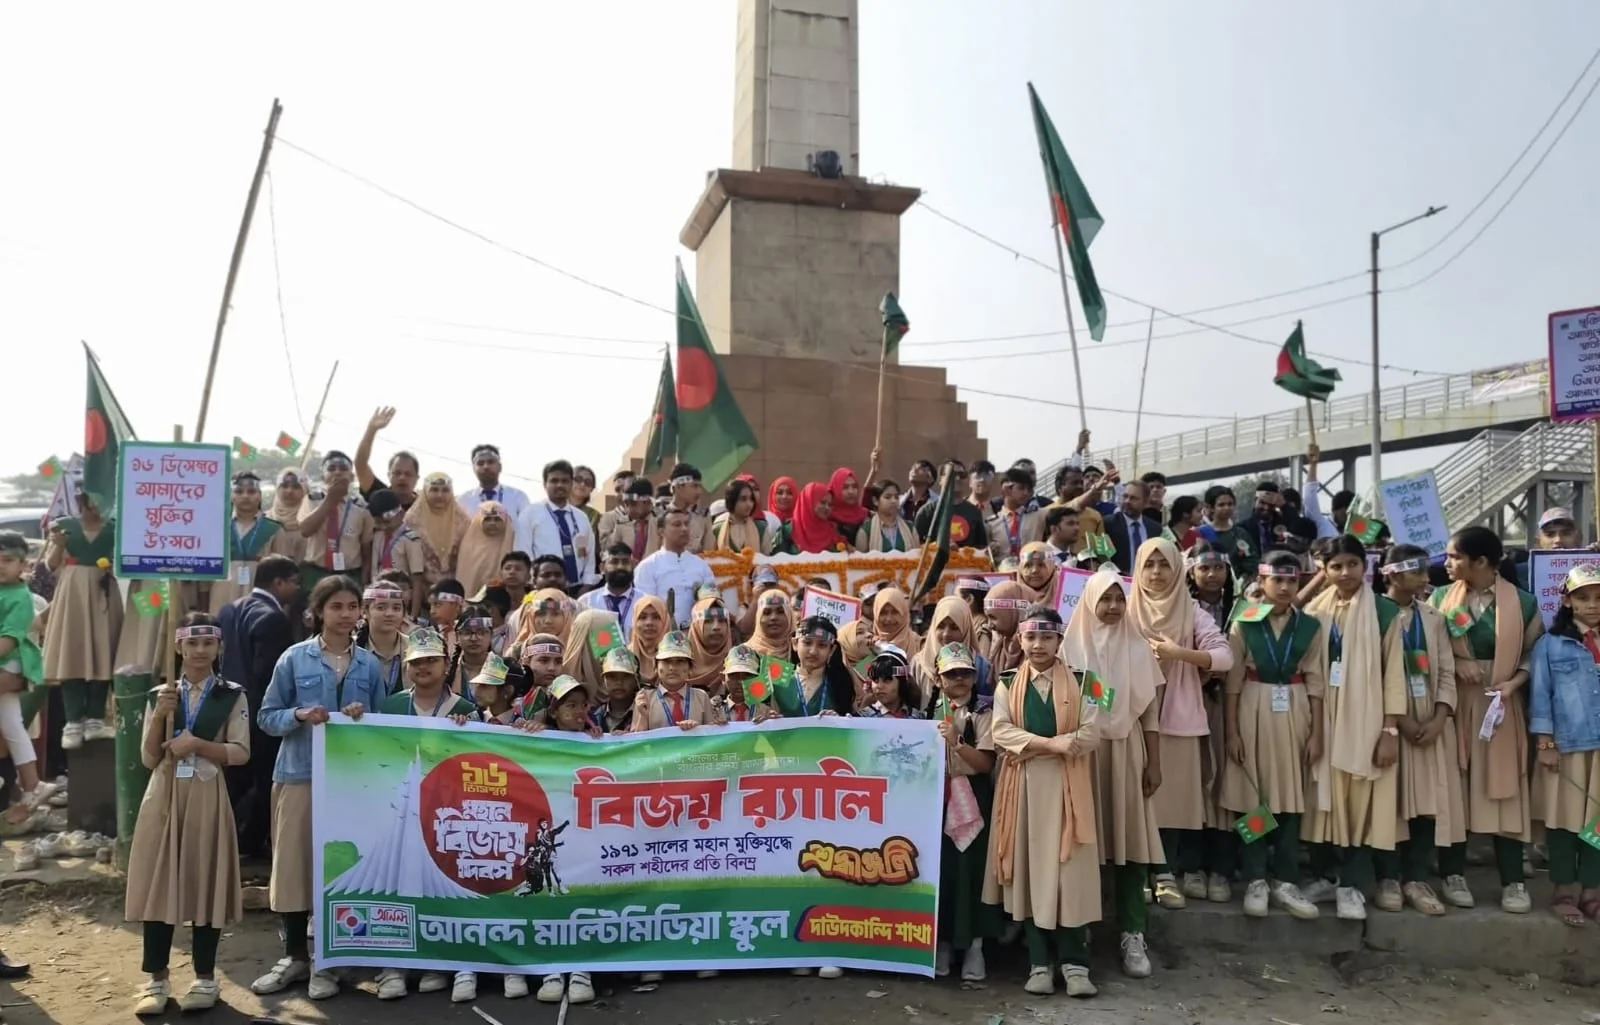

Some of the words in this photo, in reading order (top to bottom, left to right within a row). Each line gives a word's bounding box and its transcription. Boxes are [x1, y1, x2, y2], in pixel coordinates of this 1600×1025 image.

[132, 458, 154, 472] ১৬
[161, 453, 219, 478] ডিসেম্বর
[136, 482, 206, 502] আমাদের
[145, 503, 194, 528] মুক্তির
[144, 530, 201, 550] উৎসব।
[461, 761, 507, 787] ১৬
[572, 766, 729, 830] বিজয়
[462, 800, 513, 824] মহান
[433, 807, 528, 863] বিজয়
[600, 844, 638, 859] ১৯৭১
[645, 840, 689, 855] সালের
[693, 836, 730, 852] মহান
[734, 832, 794, 854] মুক্তিযুদ্ধে
[456, 852, 514, 880] দিবস
[601, 863, 635, 877] সকল
[640, 857, 689, 874] শহীদের
[693, 854, 723, 870] প্রতি
[726, 853, 757, 871] বিনম্র
[417, 914, 527, 946] আনন্দ
[532, 904, 722, 947] মাল্টিমিডিয়া
[727, 910, 790, 951] স্কুল
[809, 912, 893, 940] দাউদকান্দি
[895, 921, 932, 945] শাখা
